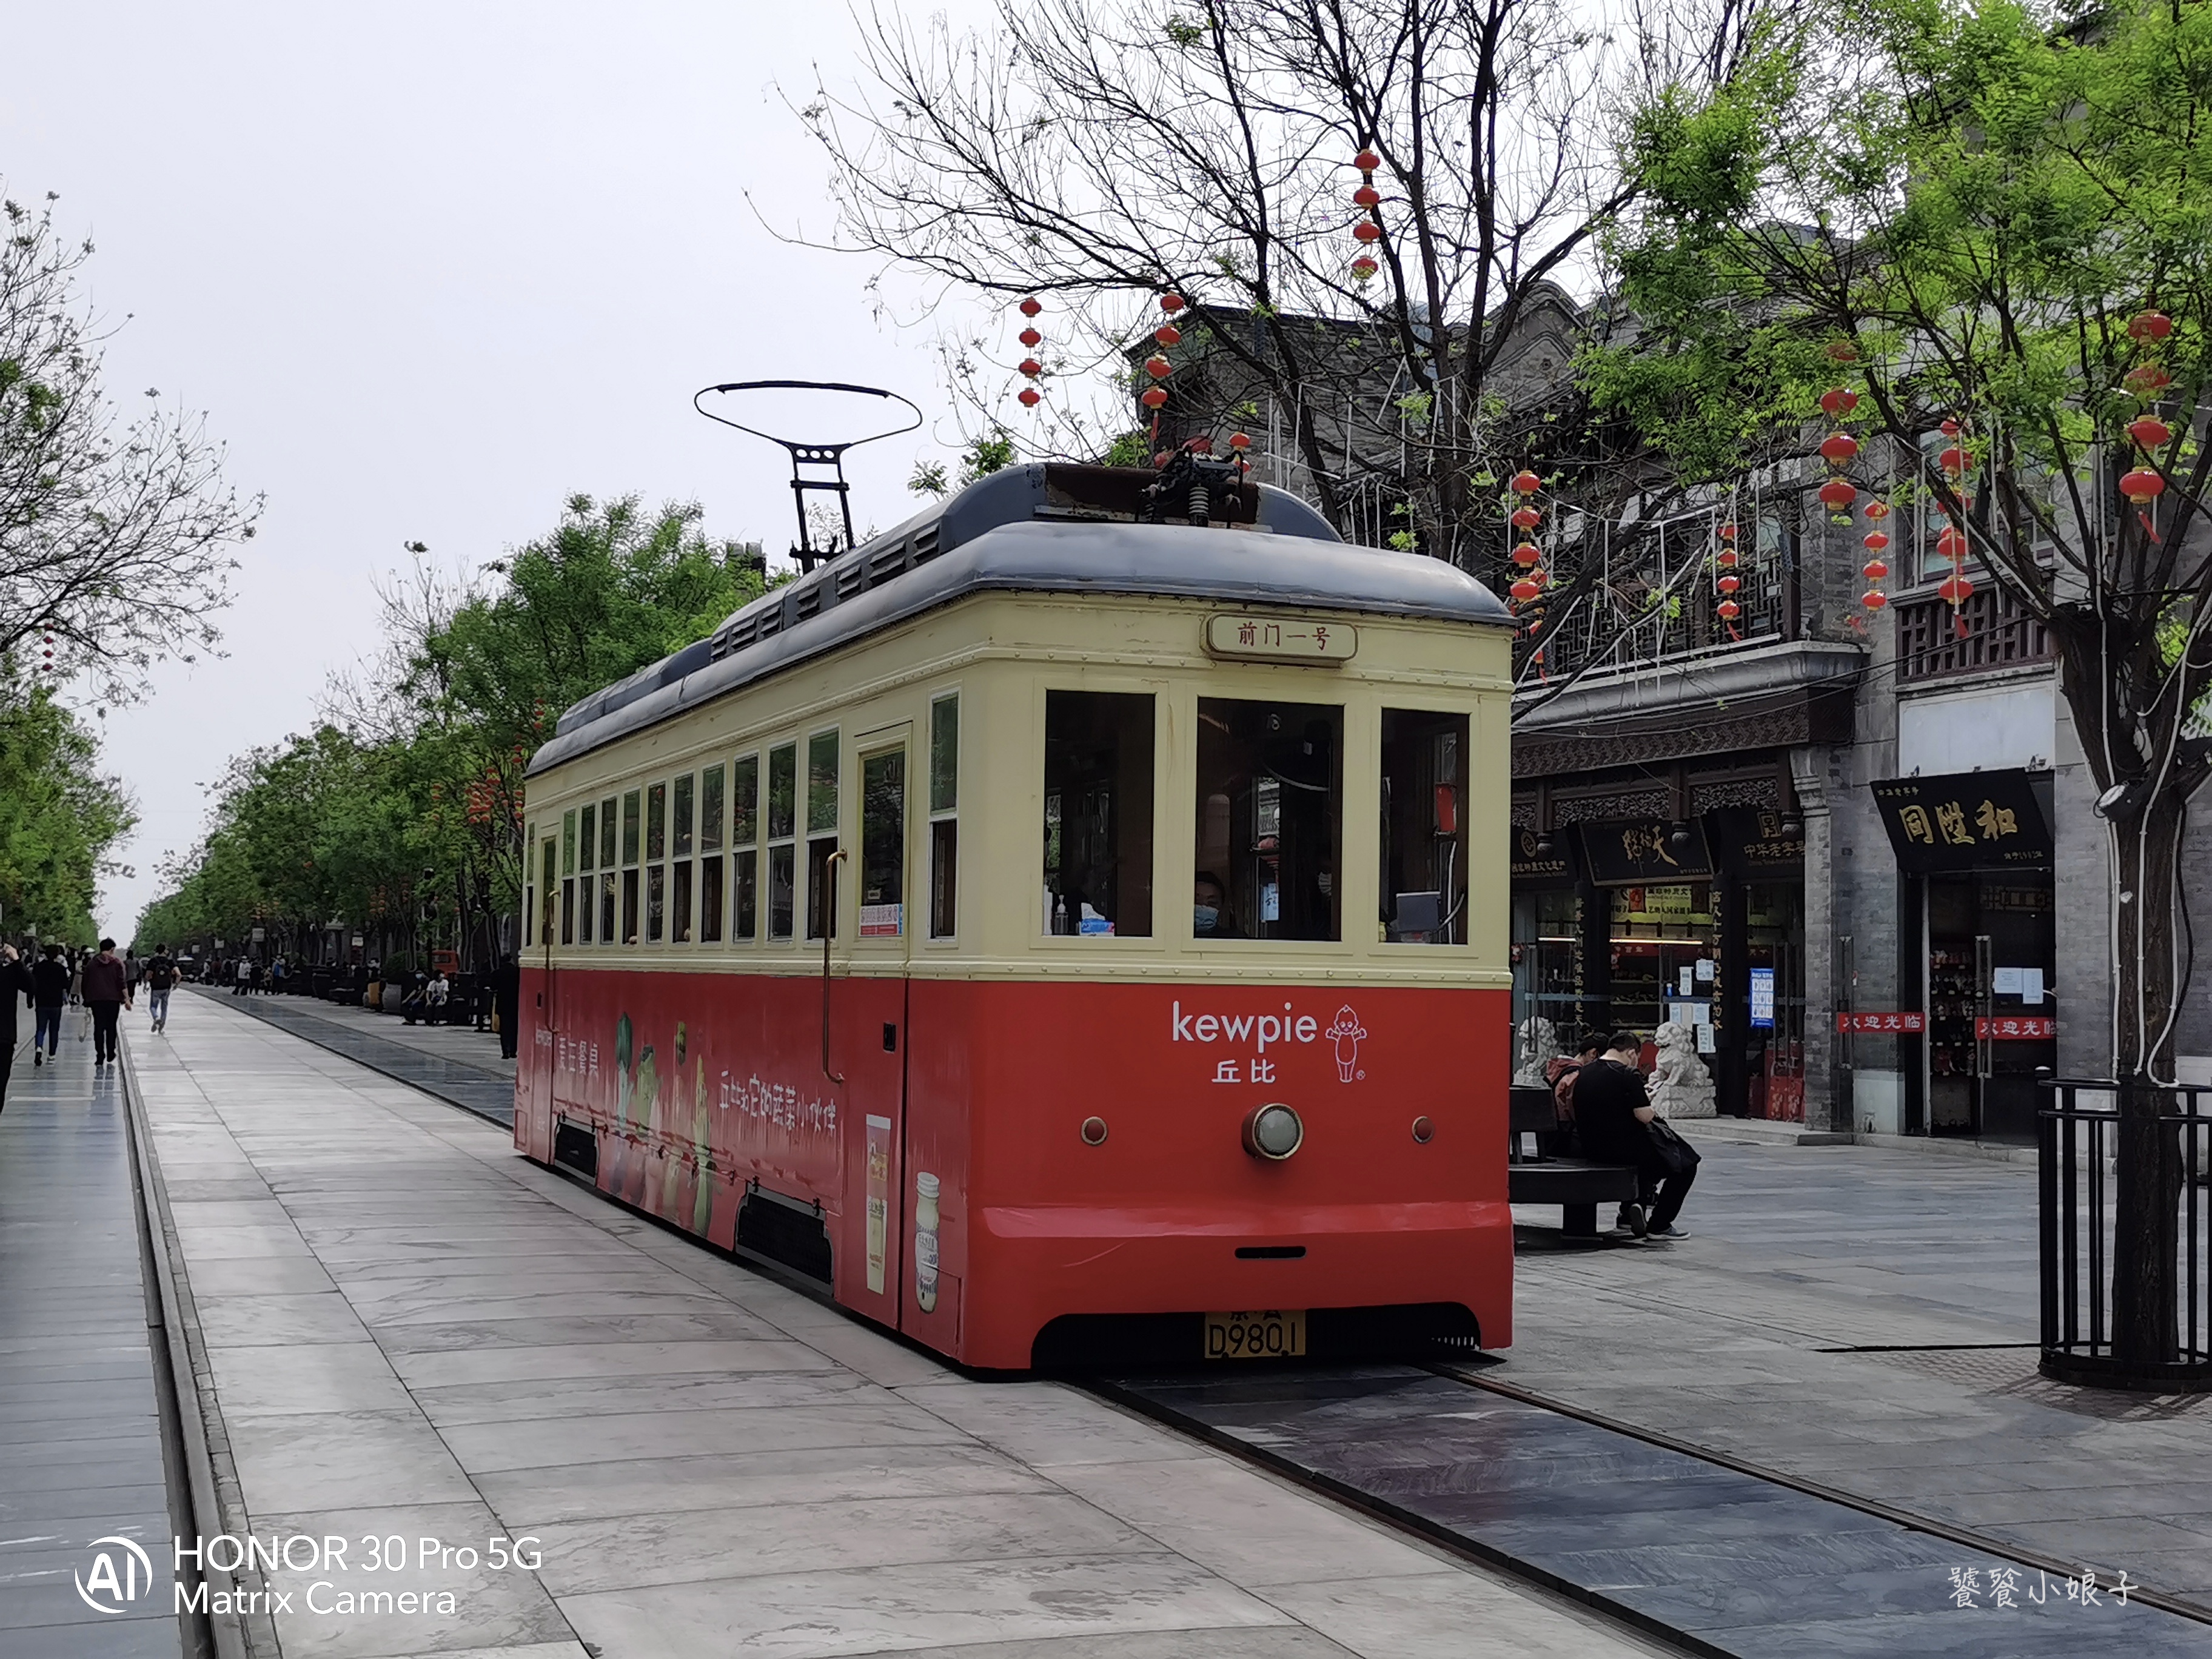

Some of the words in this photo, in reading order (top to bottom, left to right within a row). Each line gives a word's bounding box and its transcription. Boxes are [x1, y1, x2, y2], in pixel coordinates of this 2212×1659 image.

[1237, 621, 1331, 651] 前门一号
[1173, 1000, 1318, 1053] kewpie
[1843, 1014, 1922, 1030] 欢迎光临
[1212, 1059, 1276, 1084] 丘比
[719, 1070, 836, 1137] 丘比和它的蔬菜小伙伴
[1208, 1321, 1296, 1355] D9801
